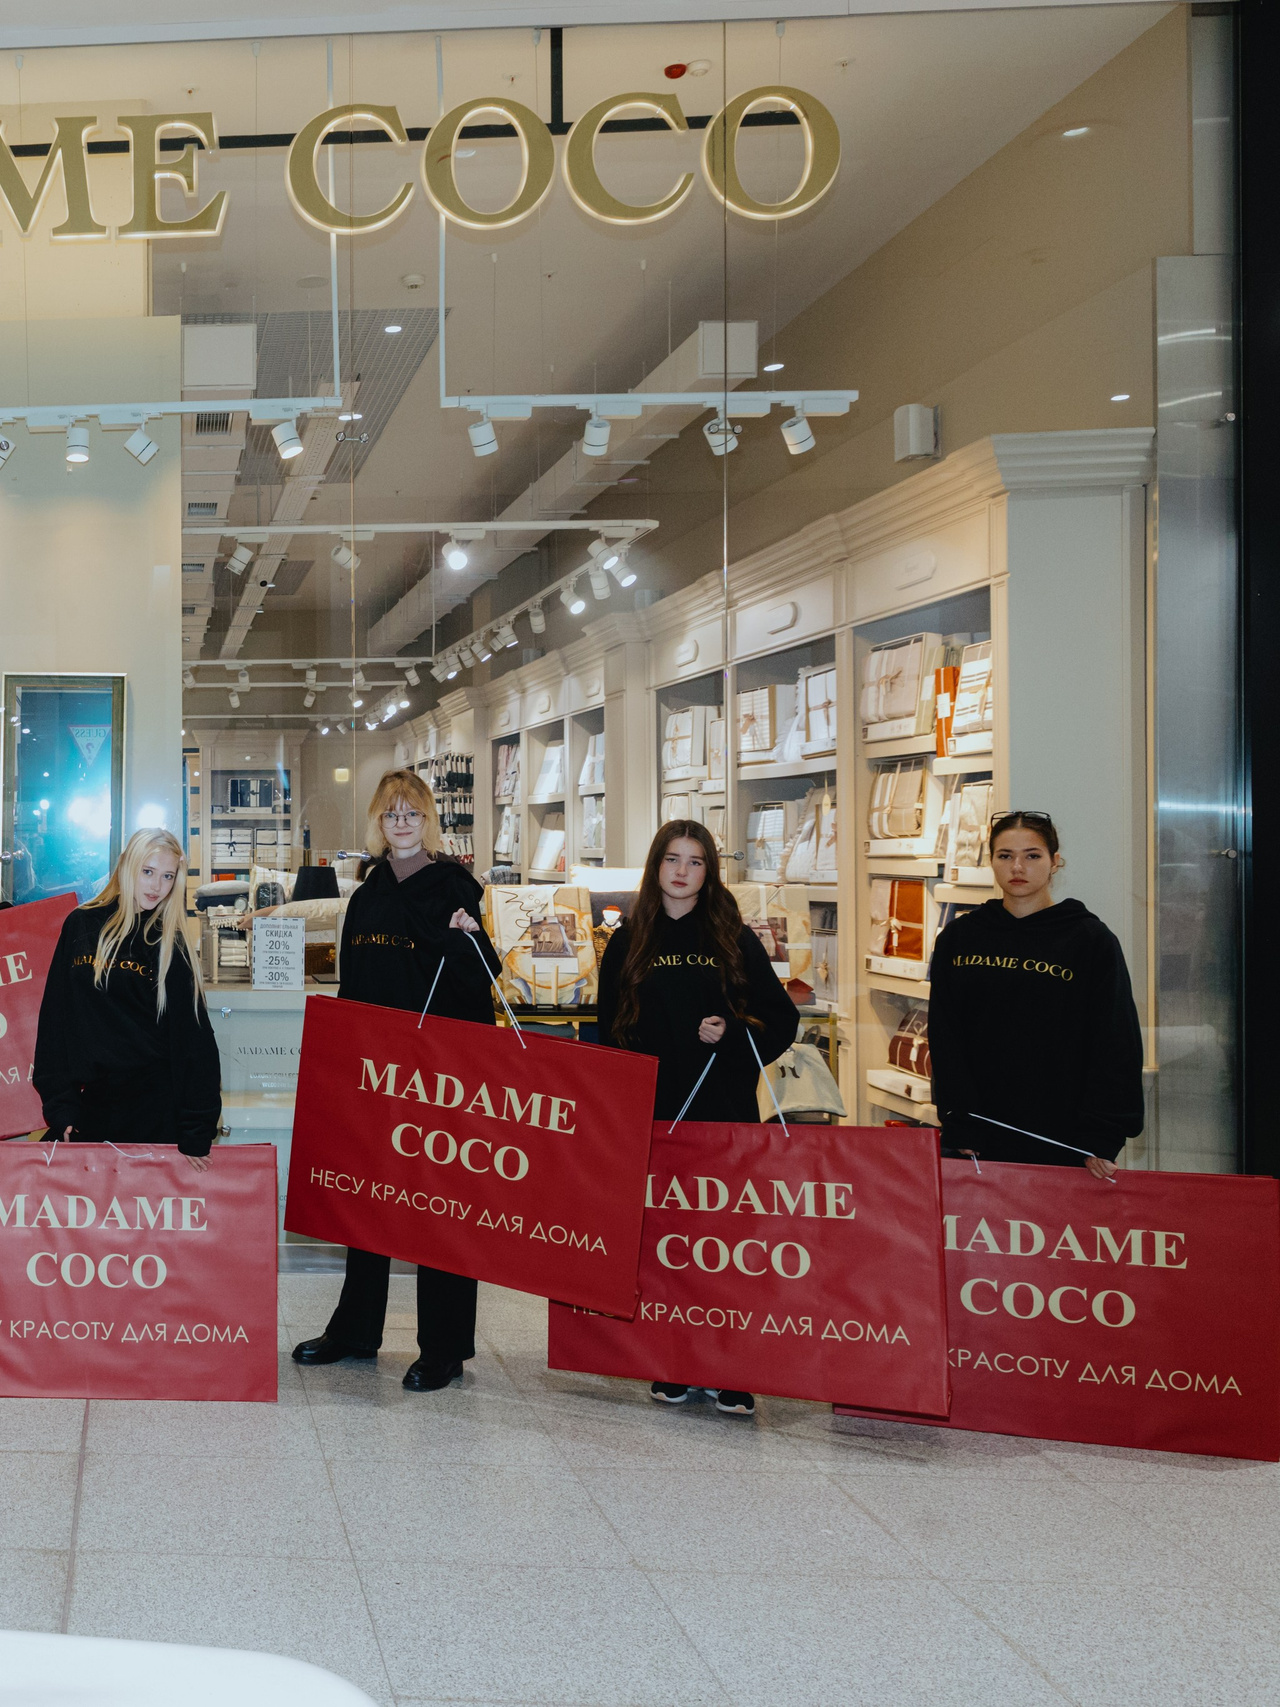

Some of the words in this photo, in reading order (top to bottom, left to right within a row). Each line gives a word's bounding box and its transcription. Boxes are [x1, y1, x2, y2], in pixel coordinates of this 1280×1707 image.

[286, 86, 841, 235] COCO
[265, 930, 293, 938] СКИДКА
[265, 940, 290, 950] -20%
[265, 956, 290, 966] -25%
[265, 971, 289, 981] -30%
[952, 955, 1019, 969] MADAME
[1022, 959, 1074, 981] COCO
[359, 1058, 576, 1134] MADAME
[392, 1123, 529, 1181] COCO
[310, 1167, 365, 1195] НЕСУ
[371, 1182, 472, 1220] КРАСОТУ
[477, 1209, 524, 1235] ДЛЯ
[530, 1222, 608, 1256] ДОМА
[26, 1251, 167, 1289] COCO
[656, 1233, 811, 1279] COCO
[960, 1278, 1136, 1328] COCO
[10, 1320, 114, 1340] КРАСОТУ
[121, 1322, 167, 1344] ДЛЯ
[173, 1324, 249, 1344] ДОМА
[641, 1302, 752, 1330] КРАСОТУ
[760, 1314, 813, 1337] ДЛЯ
[820, 1319, 910, 1346] ДОМА
[1078, 1362, 1136, 1386] ДЛЯ
[1145, 1369, 1242, 1396] ДОМА
